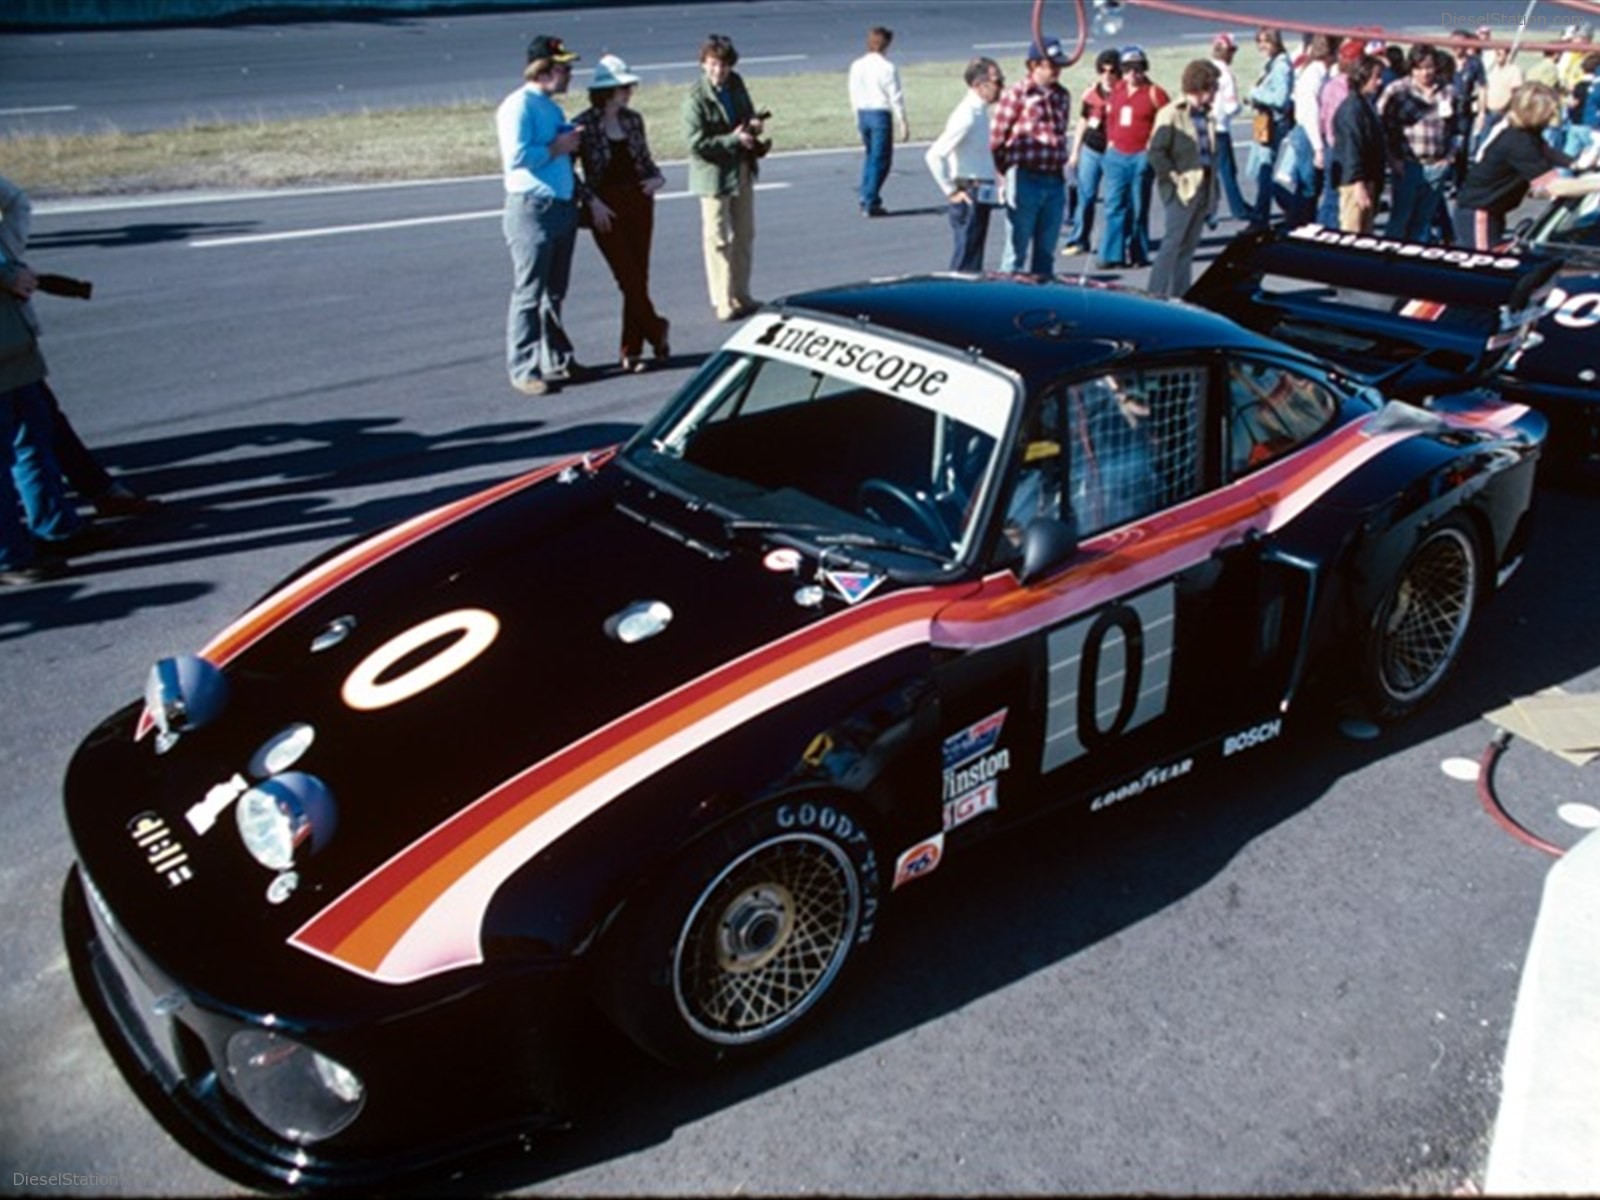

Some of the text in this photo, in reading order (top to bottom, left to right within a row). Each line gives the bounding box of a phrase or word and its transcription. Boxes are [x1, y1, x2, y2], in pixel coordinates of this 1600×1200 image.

[1287, 223, 1522, 271] Interscope
[754, 317, 949, 397] Interscope
[340, 607, 502, 711] 0
[1076, 601, 1145, 752] 0
[1222, 718, 1283, 757] BOSCH
[956, 786, 992, 820] GT
[1090, 758, 1194, 812] GOODYEAR
